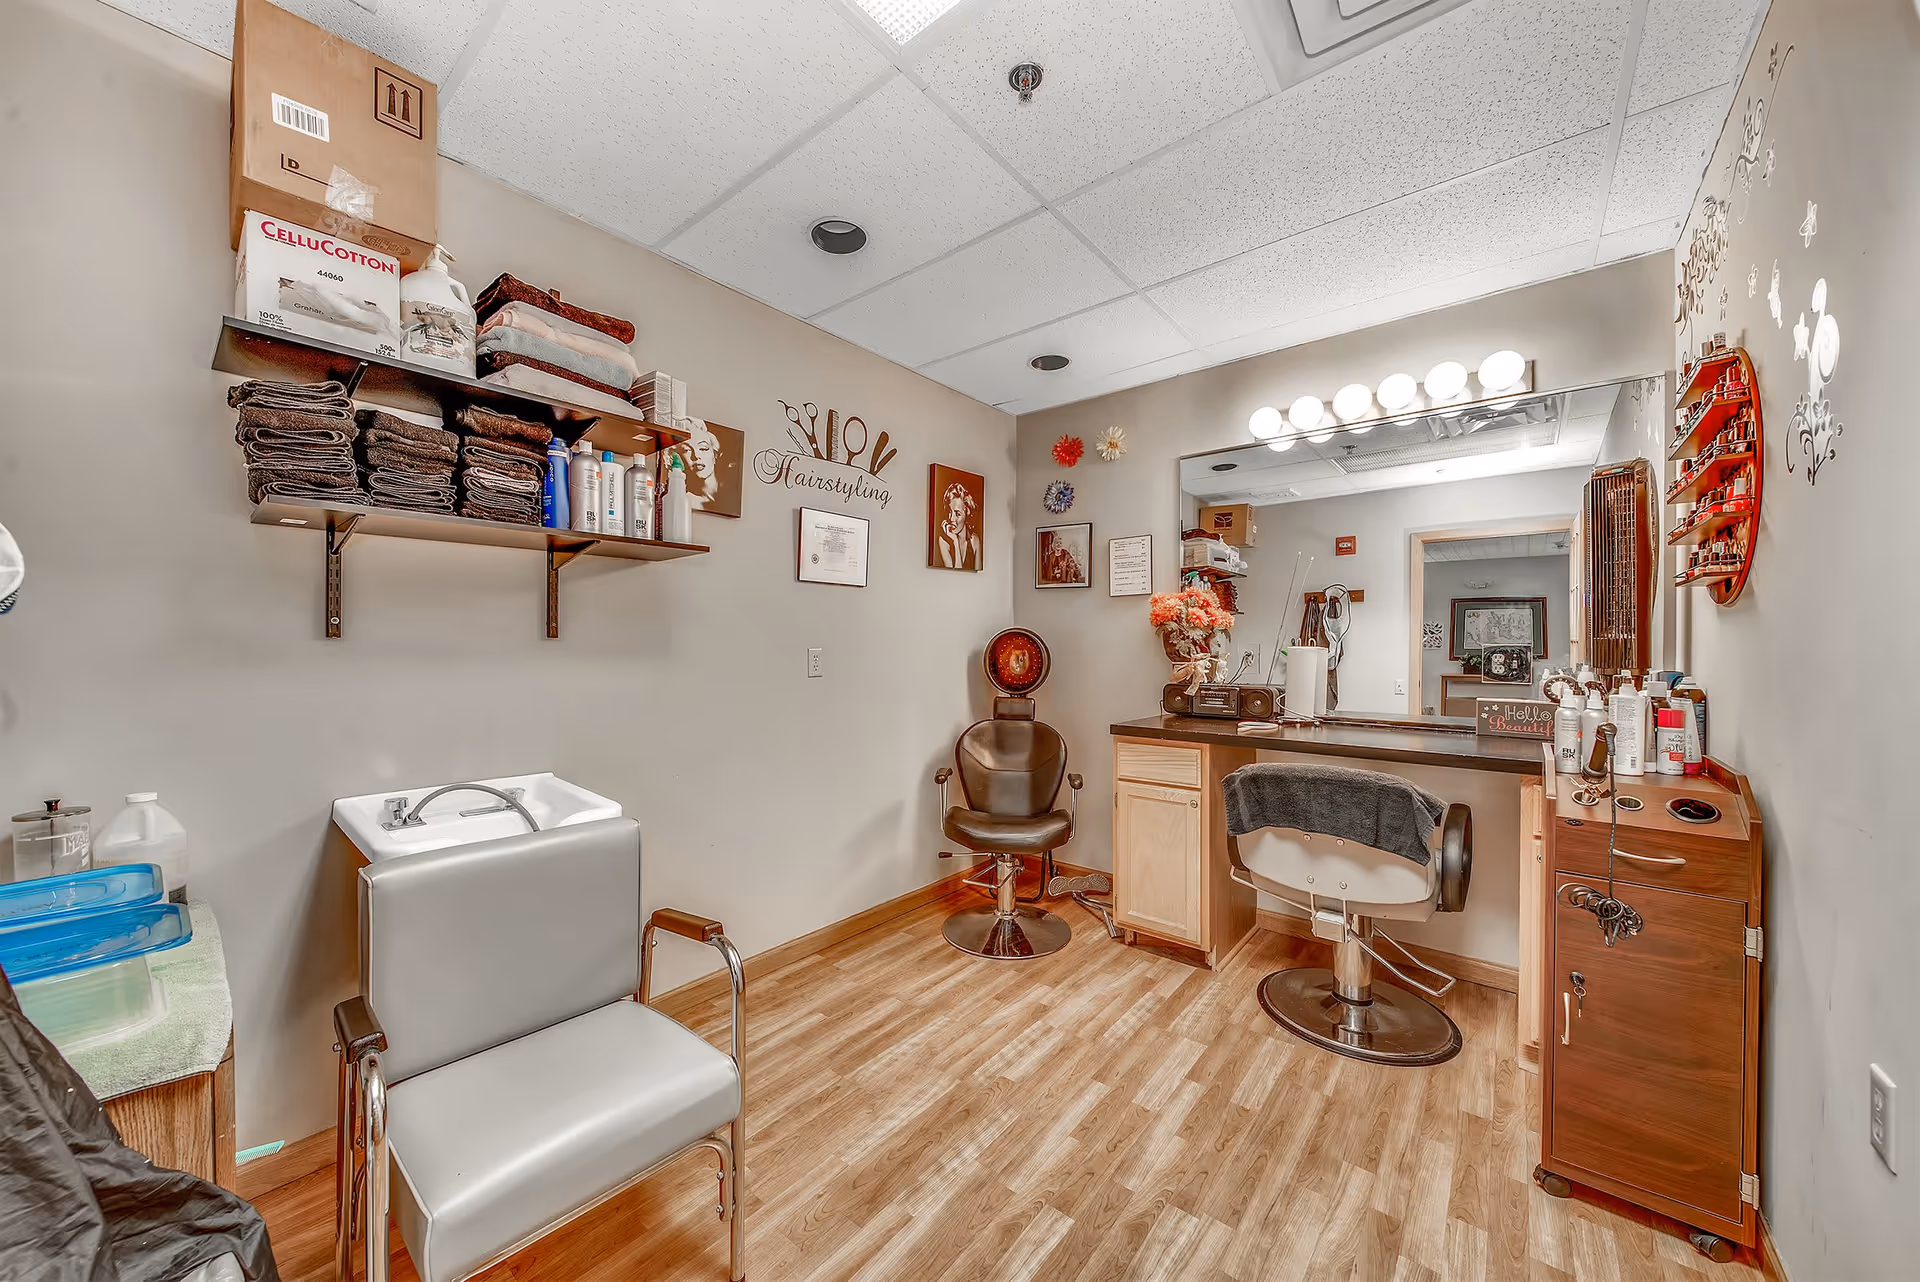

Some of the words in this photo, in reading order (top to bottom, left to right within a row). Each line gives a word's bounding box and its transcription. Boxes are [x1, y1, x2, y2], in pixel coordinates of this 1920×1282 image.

[317, 269, 344, 283] 44060
[259, 310, 284, 322] 100%
[753, 448, 892, 510] Hairstyling
[1504, 705, 1552, 723] Hello
[1489, 715, 1555, 737] Beautif
